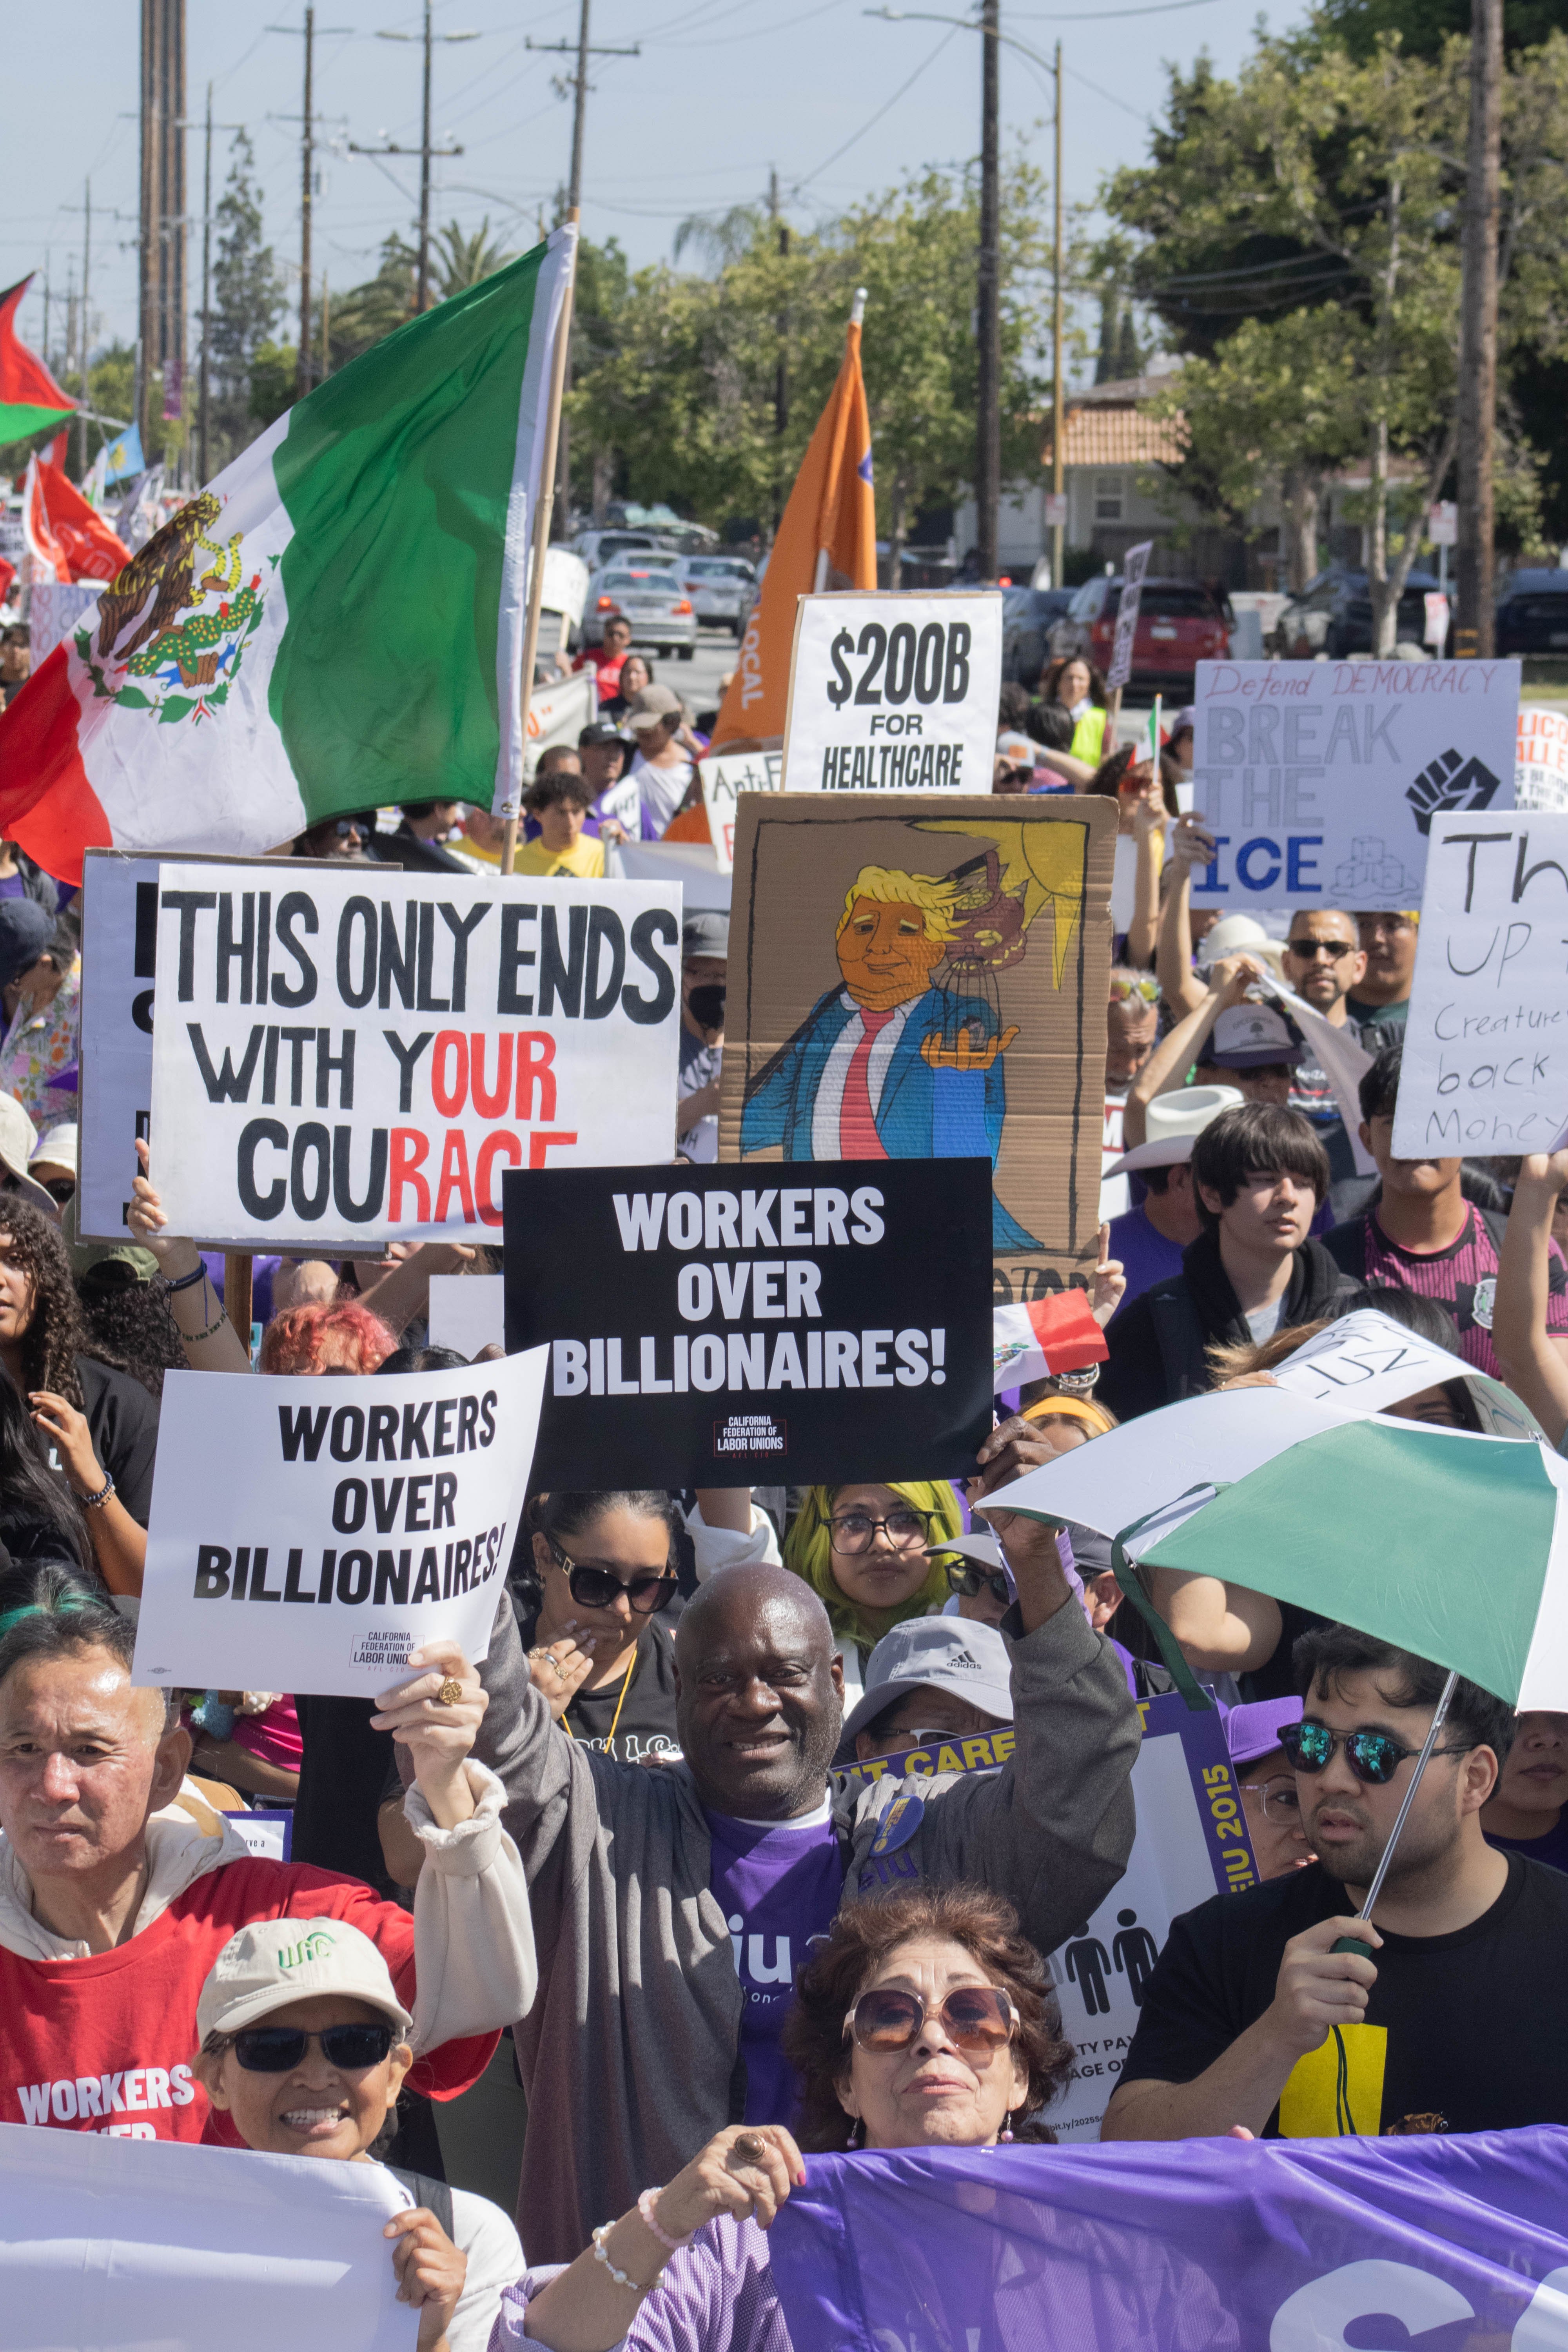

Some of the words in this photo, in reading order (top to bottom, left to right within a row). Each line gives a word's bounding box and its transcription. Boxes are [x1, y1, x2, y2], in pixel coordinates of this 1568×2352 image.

[827, 622, 971, 711] $200B
[1205, 665, 1312, 702] Defend
[1333, 663, 1497, 695] DEMOCRACY
[870, 714, 923, 736] FOR
[1207, 704, 1403, 765] BREAK
[822, 744, 964, 789] HEALTHCARE
[1195, 767, 1325, 828] THE
[1194, 836, 1323, 893] ICE
[161, 891, 319, 1008] THIS
[336, 895, 492, 1013] ONLY
[497, 903, 679, 1025] ENDS
[1447, 922, 1532, 989] UP
[186, 1023, 356, 1110] WITH
[383, 1029, 557, 1122] YOUR
[1437, 1051, 1550, 1095] back
[612, 1186, 885, 1252] WORKERS
[678, 1260, 822, 1322] OVER
[553, 1328, 946, 1397] BILLIONAIRES!
[278, 1389, 498, 1463] WORKERS
[717, 1437, 748, 1451] LABOR
[750, 1436, 784, 1450] UNIONS
[723, 1426, 766, 1437] FEDERATION
[768, 1426, 777, 1436] OF
[728, 1416, 771, 1427] CALIFORNIA
[331, 1471, 459, 1535] OVER
[193, 1521, 506, 1606] BILLIONAIRES!
[353, 1651, 385, 1664] LABOR
[387, 1653, 410, 1665] UNIO
[361, 1642, 405, 1651] FEDERATION
[407, 1642, 416, 1651] OF
[368, 1632, 411, 1641] CALIFORNIA
[946, 1661, 982, 1670] adidas
[904, 1731, 1017, 1777] CARE
[1201, 1764, 1244, 1840] 2015
[17, 2064, 195, 2126] WORKERS
